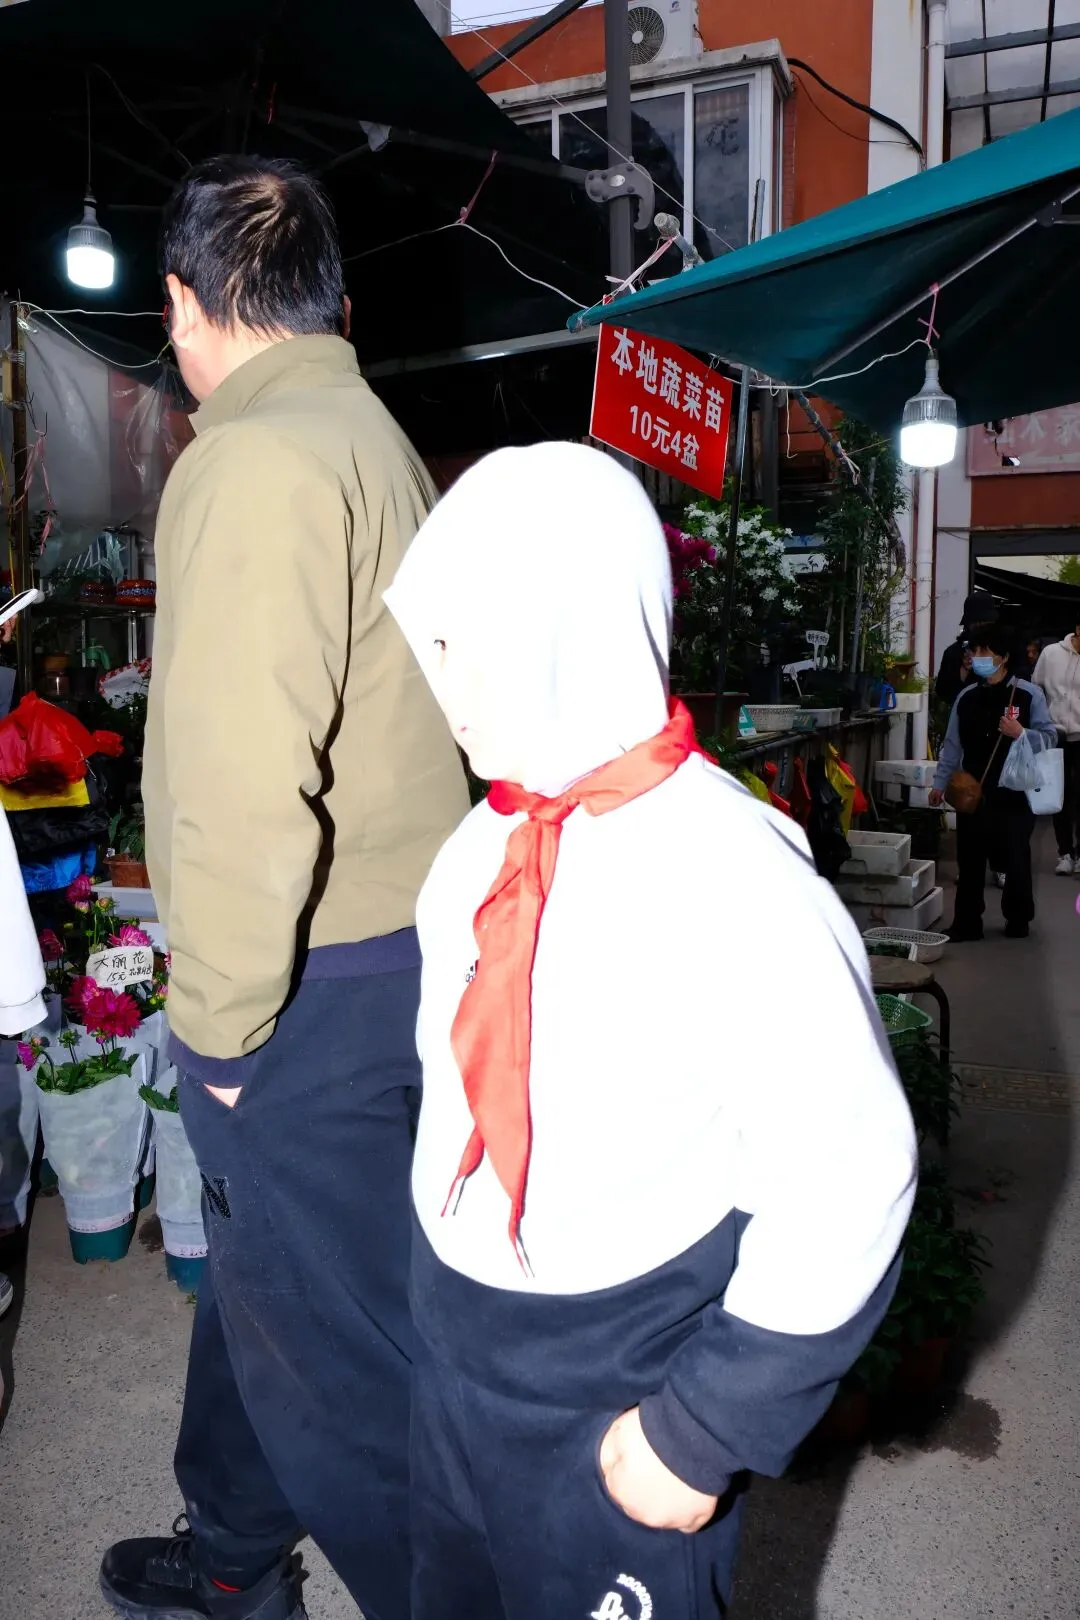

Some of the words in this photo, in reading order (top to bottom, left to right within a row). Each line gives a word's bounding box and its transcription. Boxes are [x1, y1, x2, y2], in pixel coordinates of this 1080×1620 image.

[611, 328, 724, 434] 本地蔬菜苗
[630, 405, 700, 471] 10元4盆
[94, 951, 145, 971] 大丽花
[107, 972, 126, 982] 15元
